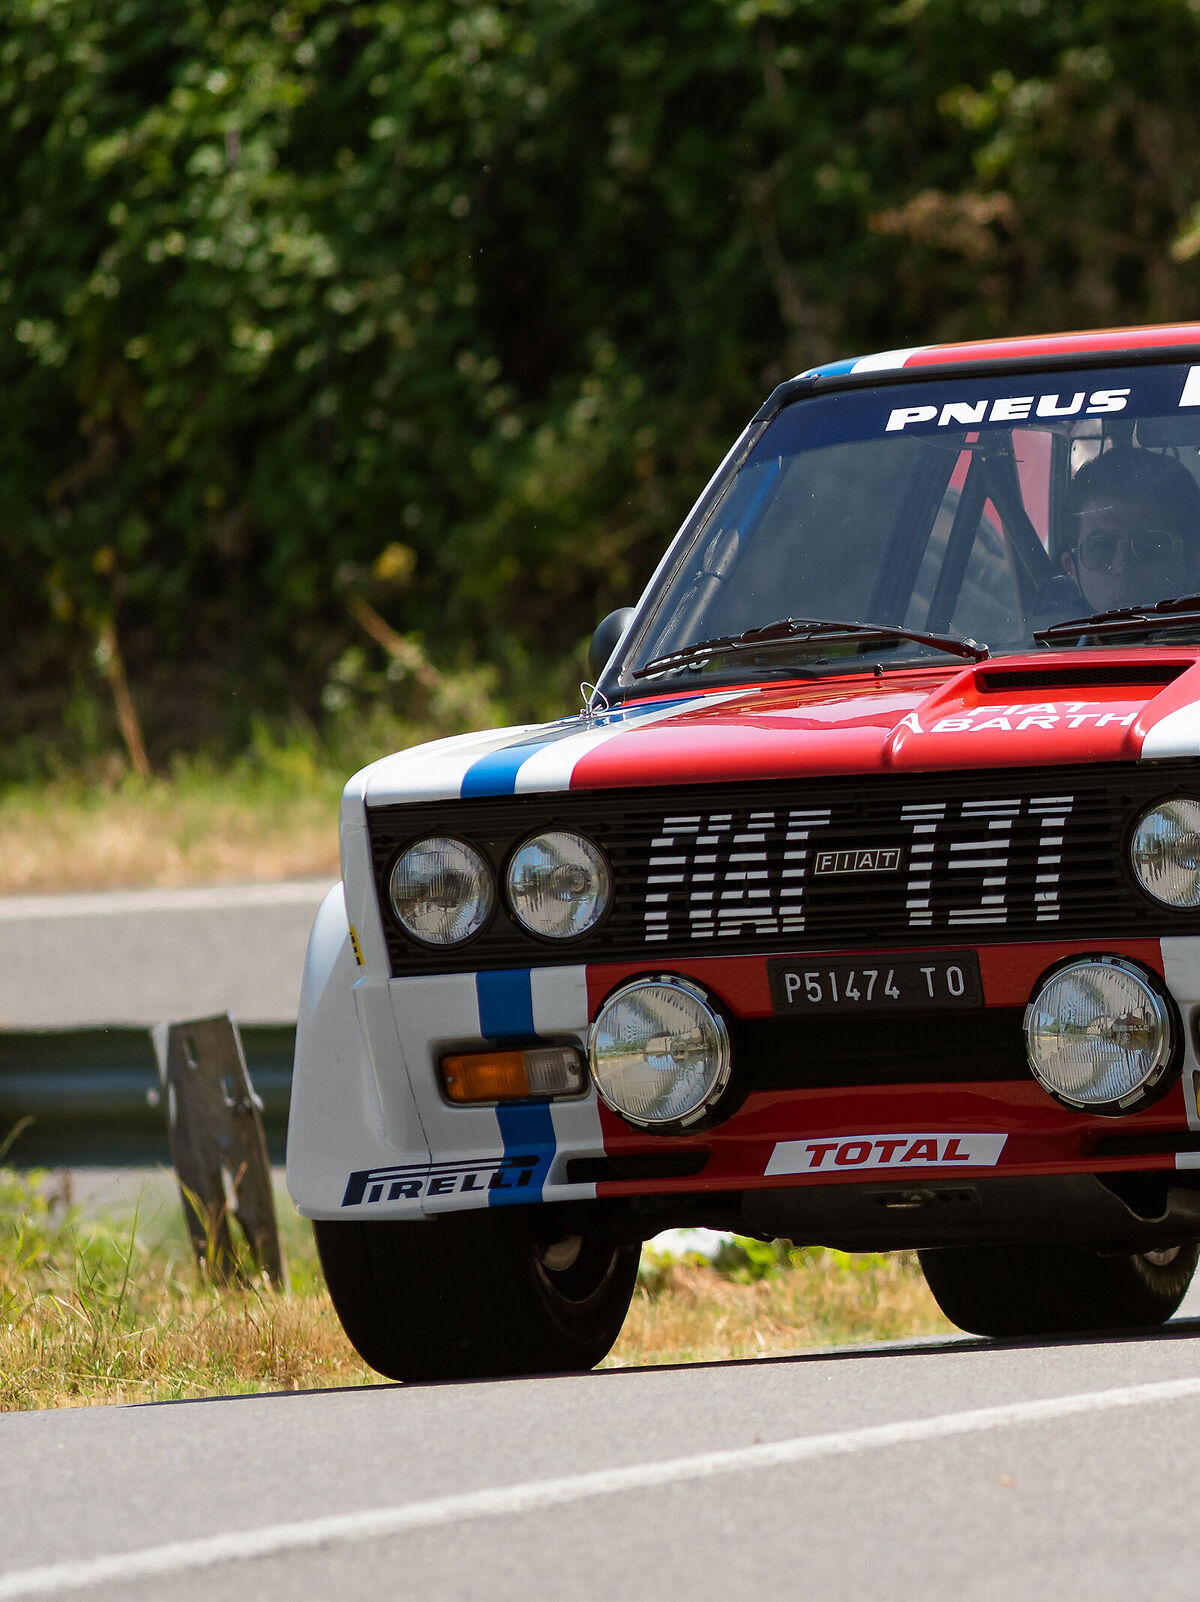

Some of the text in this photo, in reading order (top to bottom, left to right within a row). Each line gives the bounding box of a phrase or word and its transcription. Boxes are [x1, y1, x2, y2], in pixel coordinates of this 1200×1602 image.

[885, 388, 1132, 432] PNEUS
[887, 711, 1138, 735] ABARTH
[968, 702, 1100, 717] FIAT
[818, 849, 899, 872] FIAT
[784, 967, 900, 1004] P51474
[805, 1138, 971, 1167] TOTAL
[342, 1155, 539, 1207] PIRELLI
